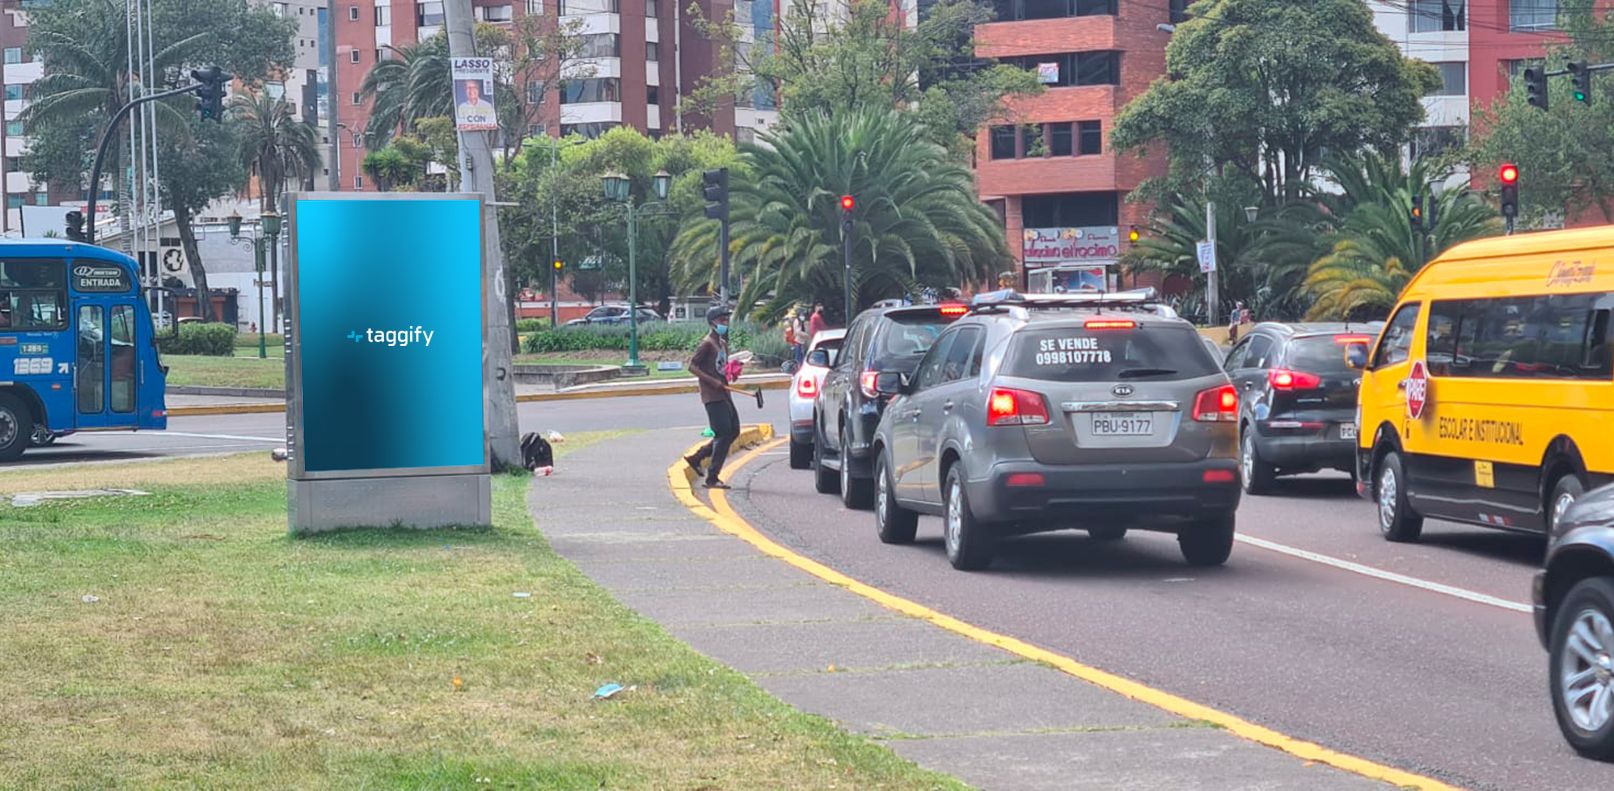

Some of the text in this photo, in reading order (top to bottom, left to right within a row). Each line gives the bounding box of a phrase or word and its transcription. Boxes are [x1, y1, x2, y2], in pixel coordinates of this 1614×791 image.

[454, 59, 490, 69] LASSO
[466, 115, 487, 123] CON
[80, 278, 121, 287] ENTRADA
[366, 325, 434, 347] taggify
[1040, 338, 1098, 352] SE VENDE
[1036, 350, 1112, 365] 0998107778
[1407, 379, 1426, 401] PARE
[1094, 419, 1151, 433] PBU-9177
[1440, 416, 1524, 446] ESCOLAR E INSTITUCIONAL
